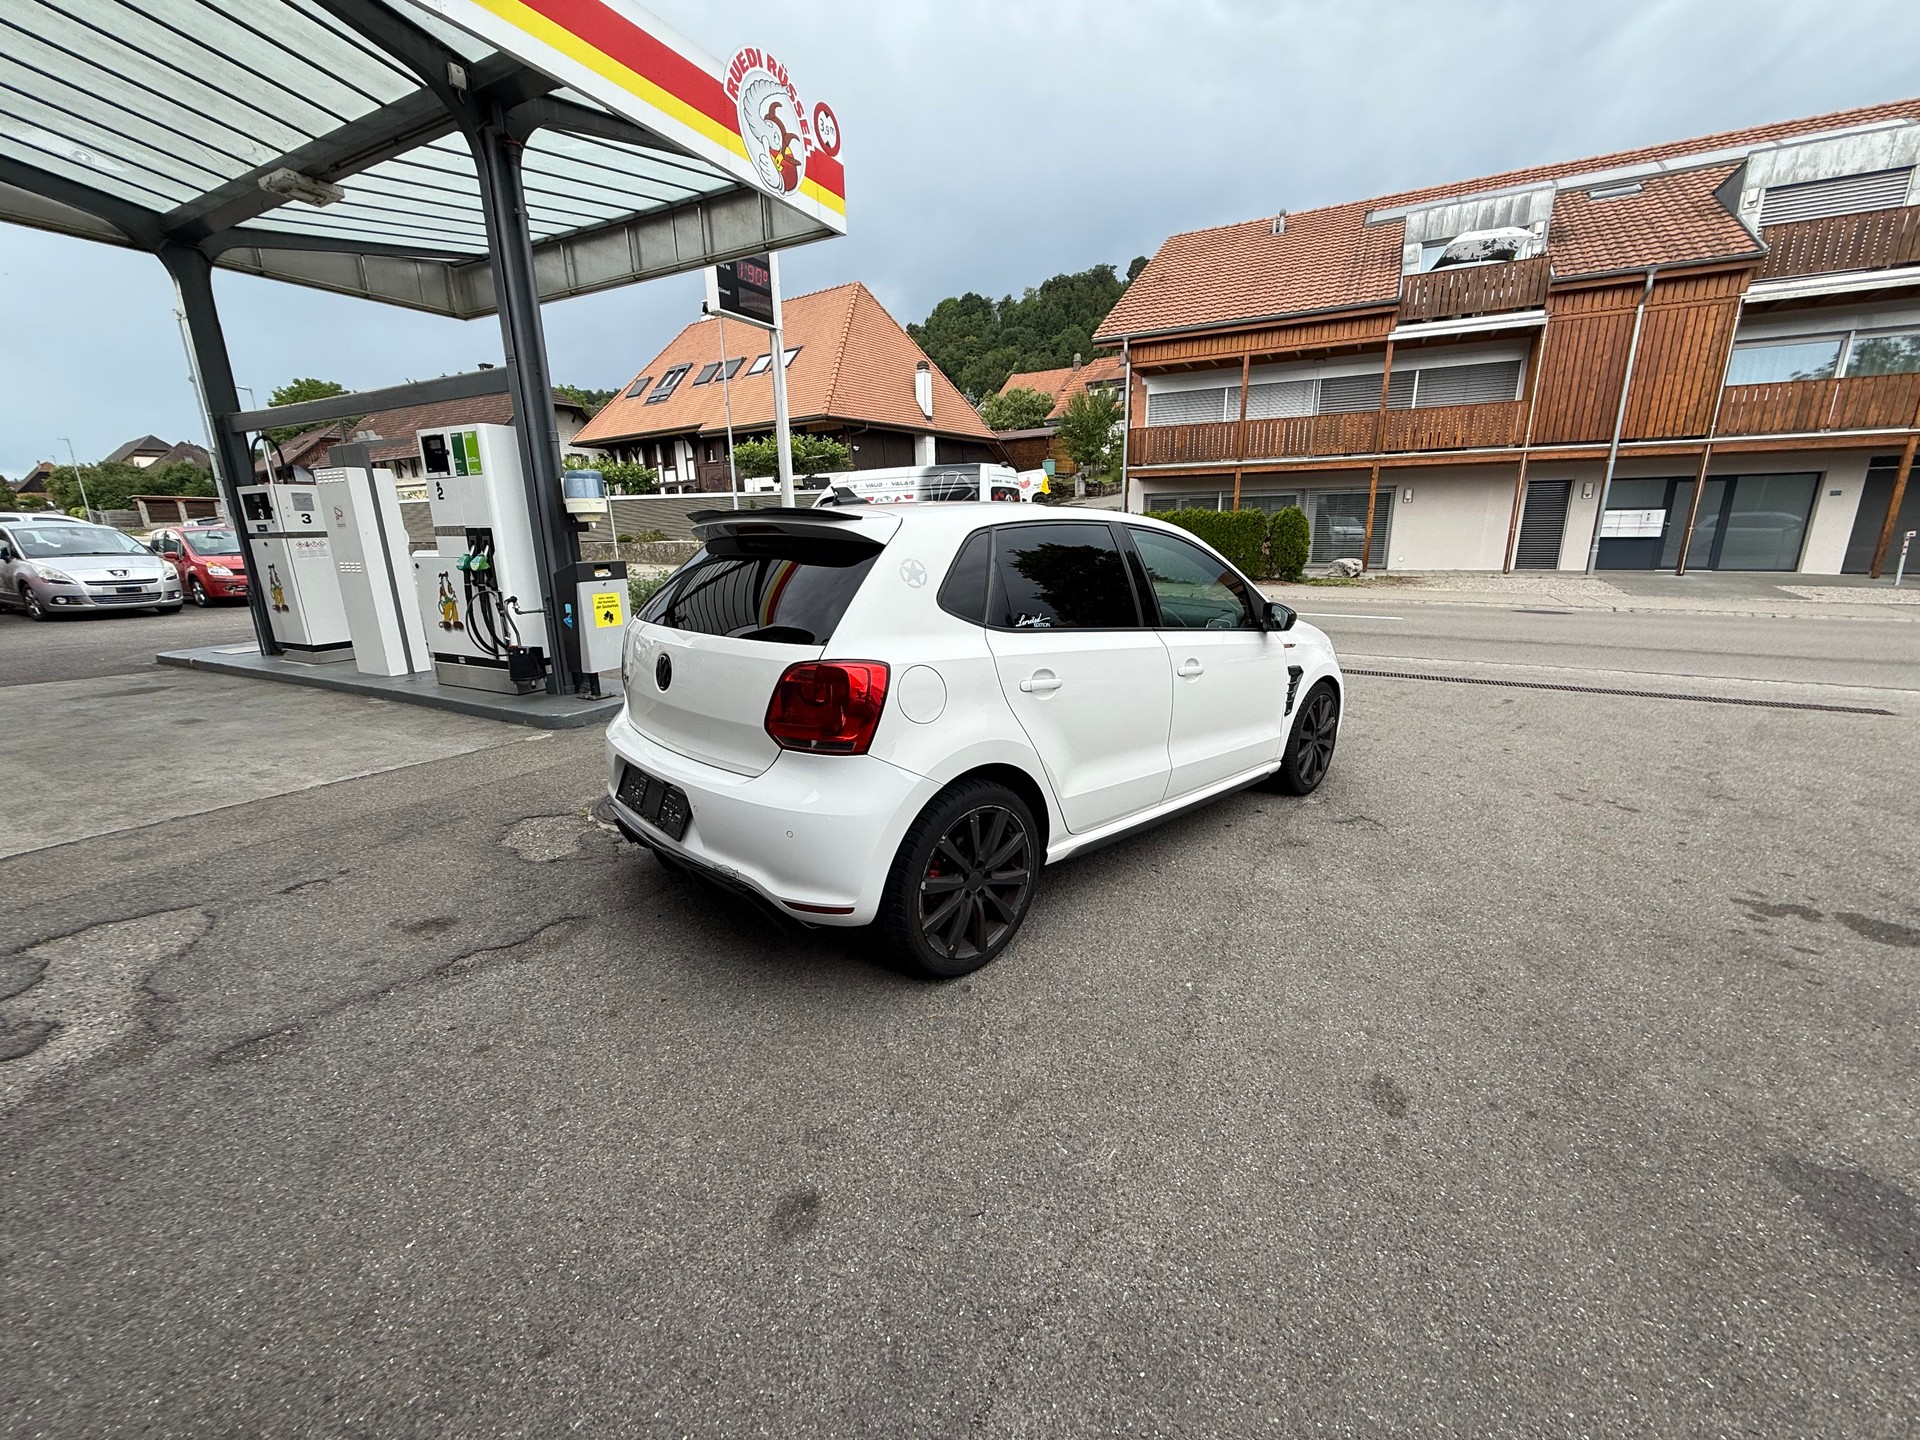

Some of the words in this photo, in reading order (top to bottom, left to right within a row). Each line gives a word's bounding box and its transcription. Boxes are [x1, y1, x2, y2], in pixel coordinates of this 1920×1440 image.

[726, 47, 764, 101] RUEDI
[766, 53, 813, 152] RÜSSEL
[437, 486, 445, 500] 2
[258, 508, 265, 520] 3
[301, 513, 312, 524] 3
